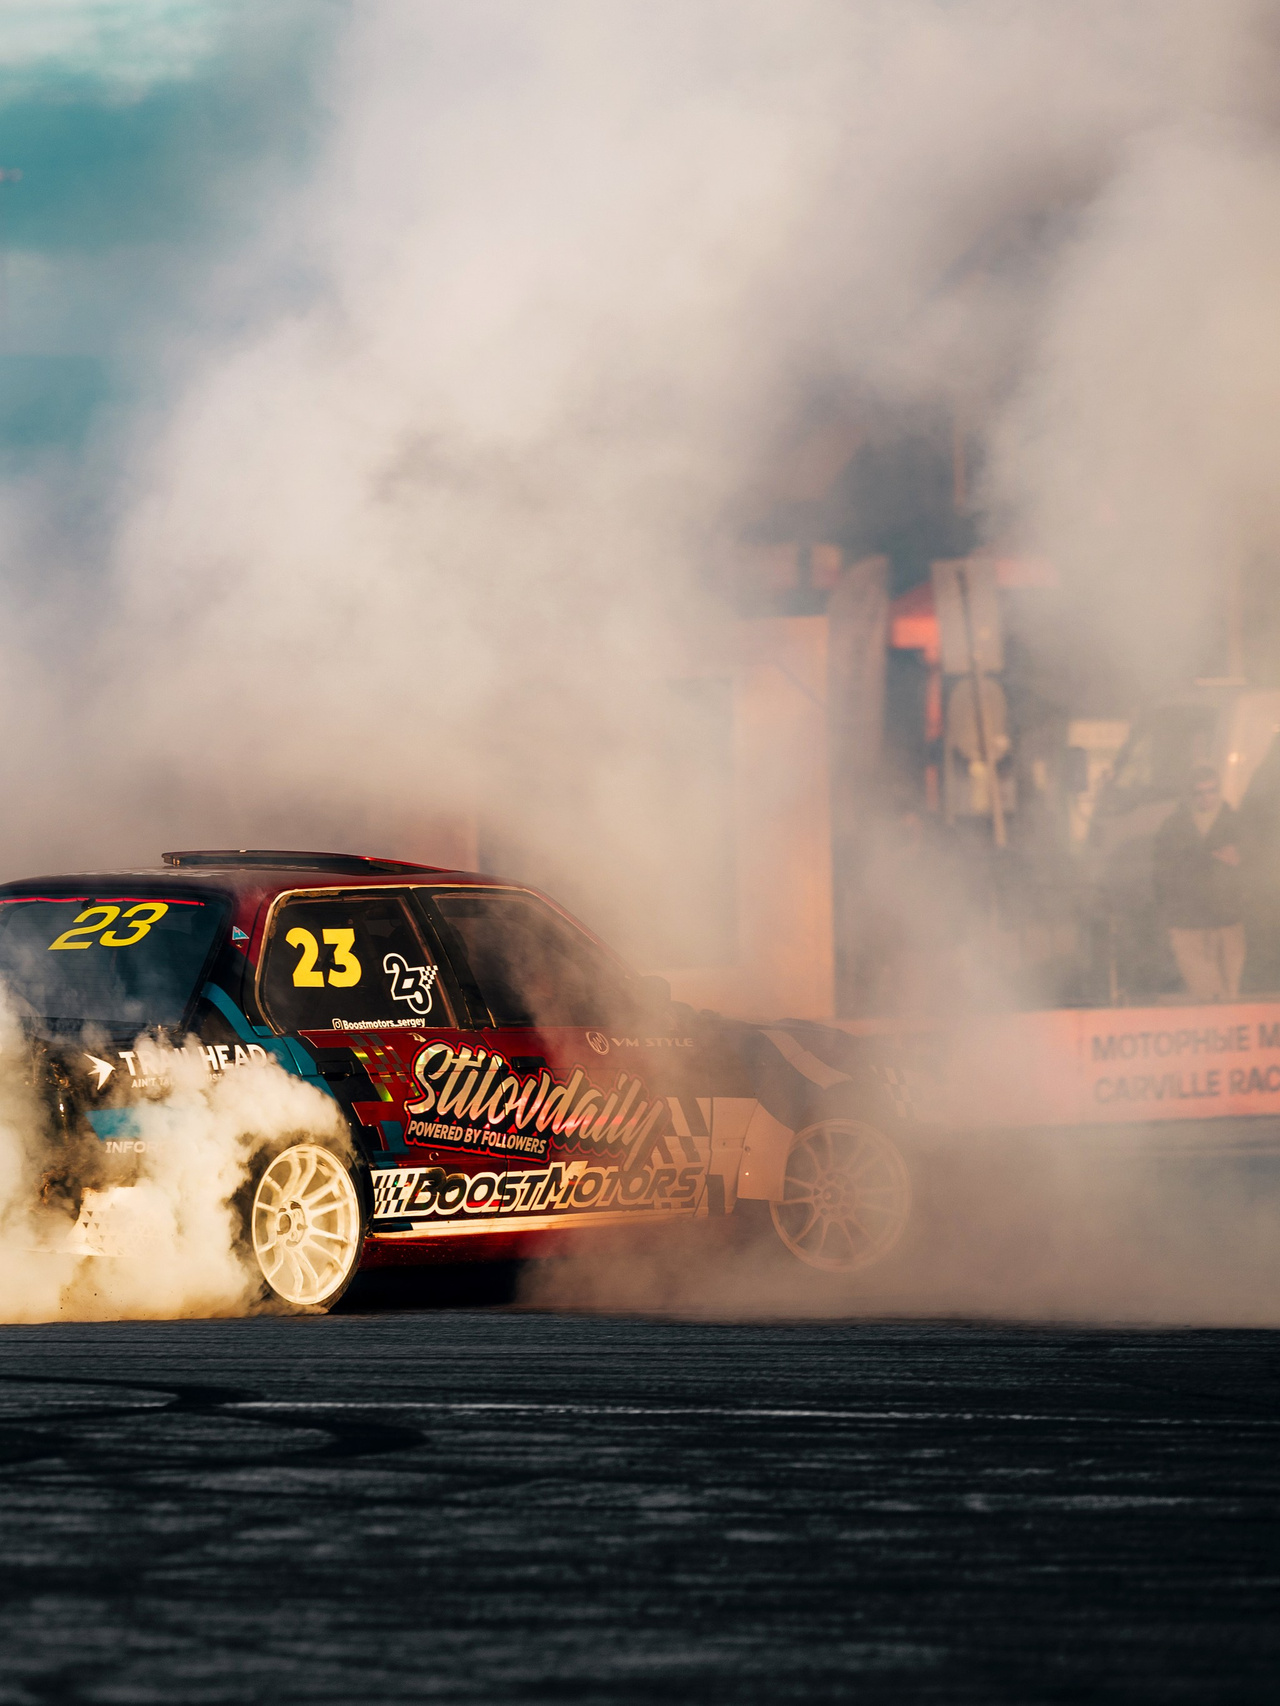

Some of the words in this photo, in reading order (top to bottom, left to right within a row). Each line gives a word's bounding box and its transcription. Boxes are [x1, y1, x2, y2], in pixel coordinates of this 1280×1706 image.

[48, 902, 169, 950] 23
[285, 927, 362, 988] 23
[343, 1018, 425, 1030] Boostmotors_sergey
[199, 1044, 268, 1071] HEAD
[611, 1038, 639, 1047] VM
[645, 1038, 694, 1047] STYLE
[408, 1120, 463, 1141] POWERED
[464, 1129, 481, 1144] BY
[481, 1131, 547, 1154] FOLLOWERS
